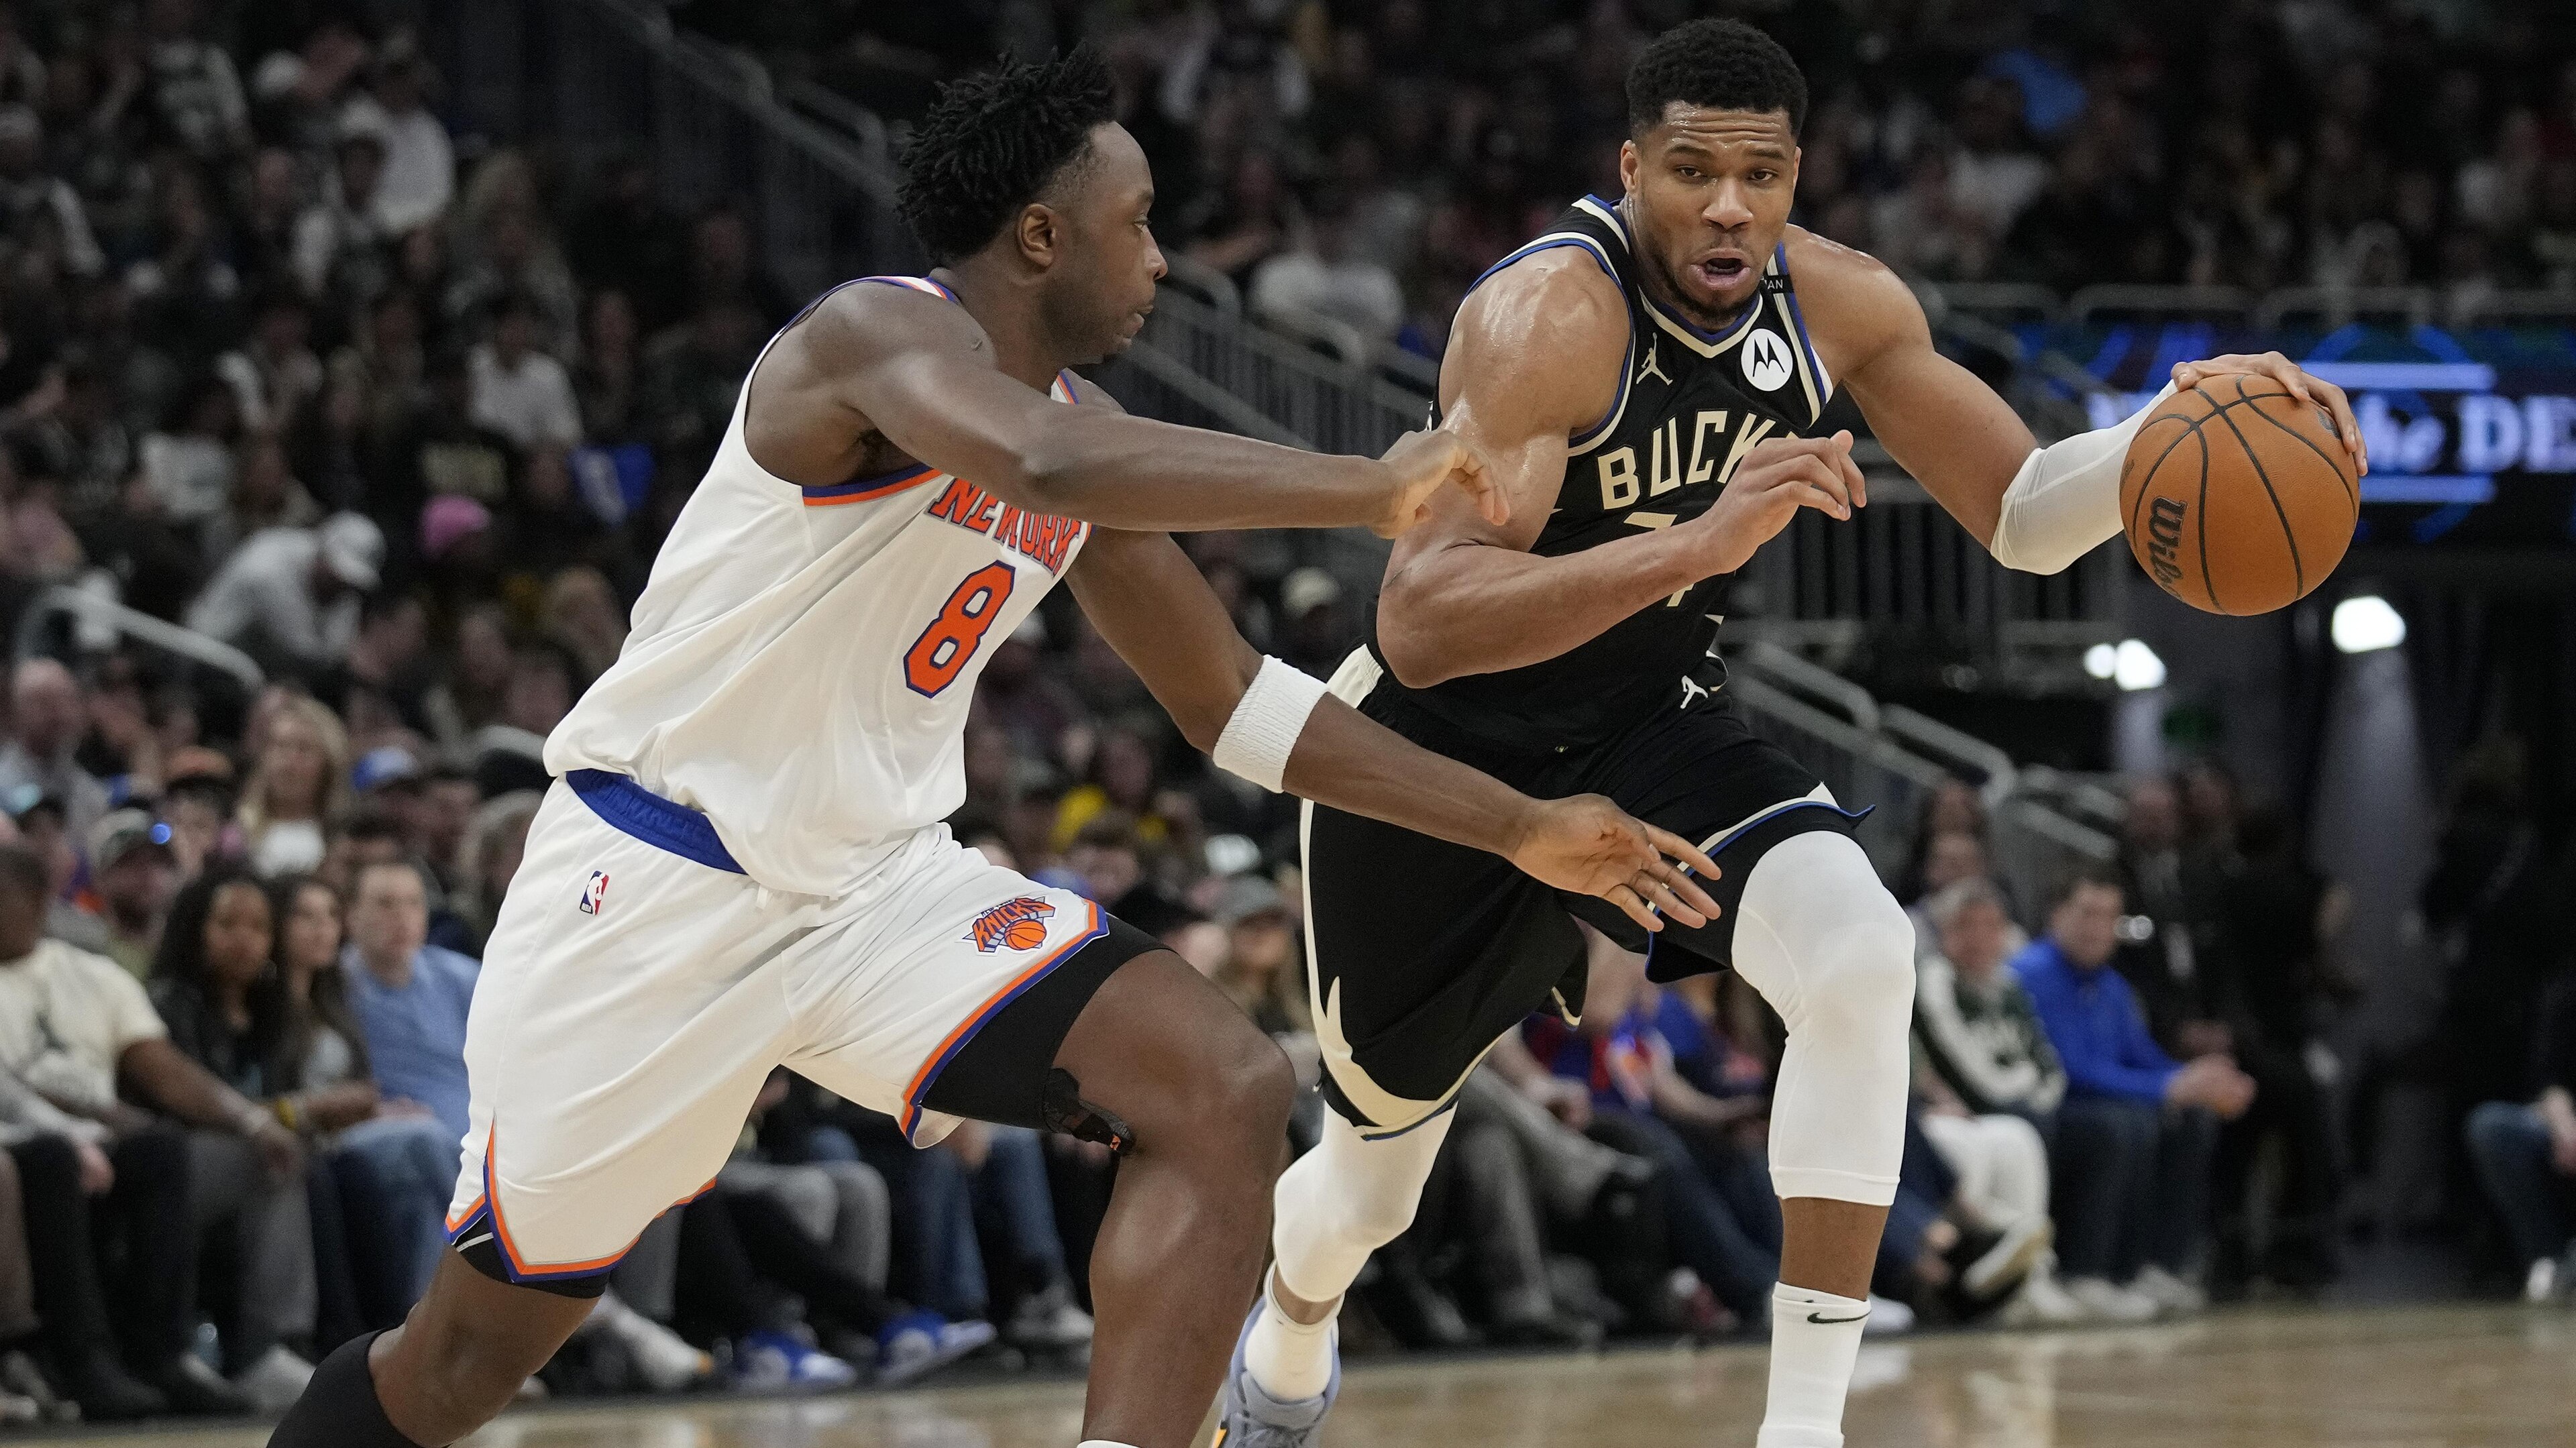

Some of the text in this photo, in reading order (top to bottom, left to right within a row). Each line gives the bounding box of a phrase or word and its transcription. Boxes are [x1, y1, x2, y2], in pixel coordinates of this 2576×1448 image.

[1597, 410, 1800, 510] BUCK
[903, 559, 1016, 699] 8
[972, 897, 1056, 952] KNICKS
